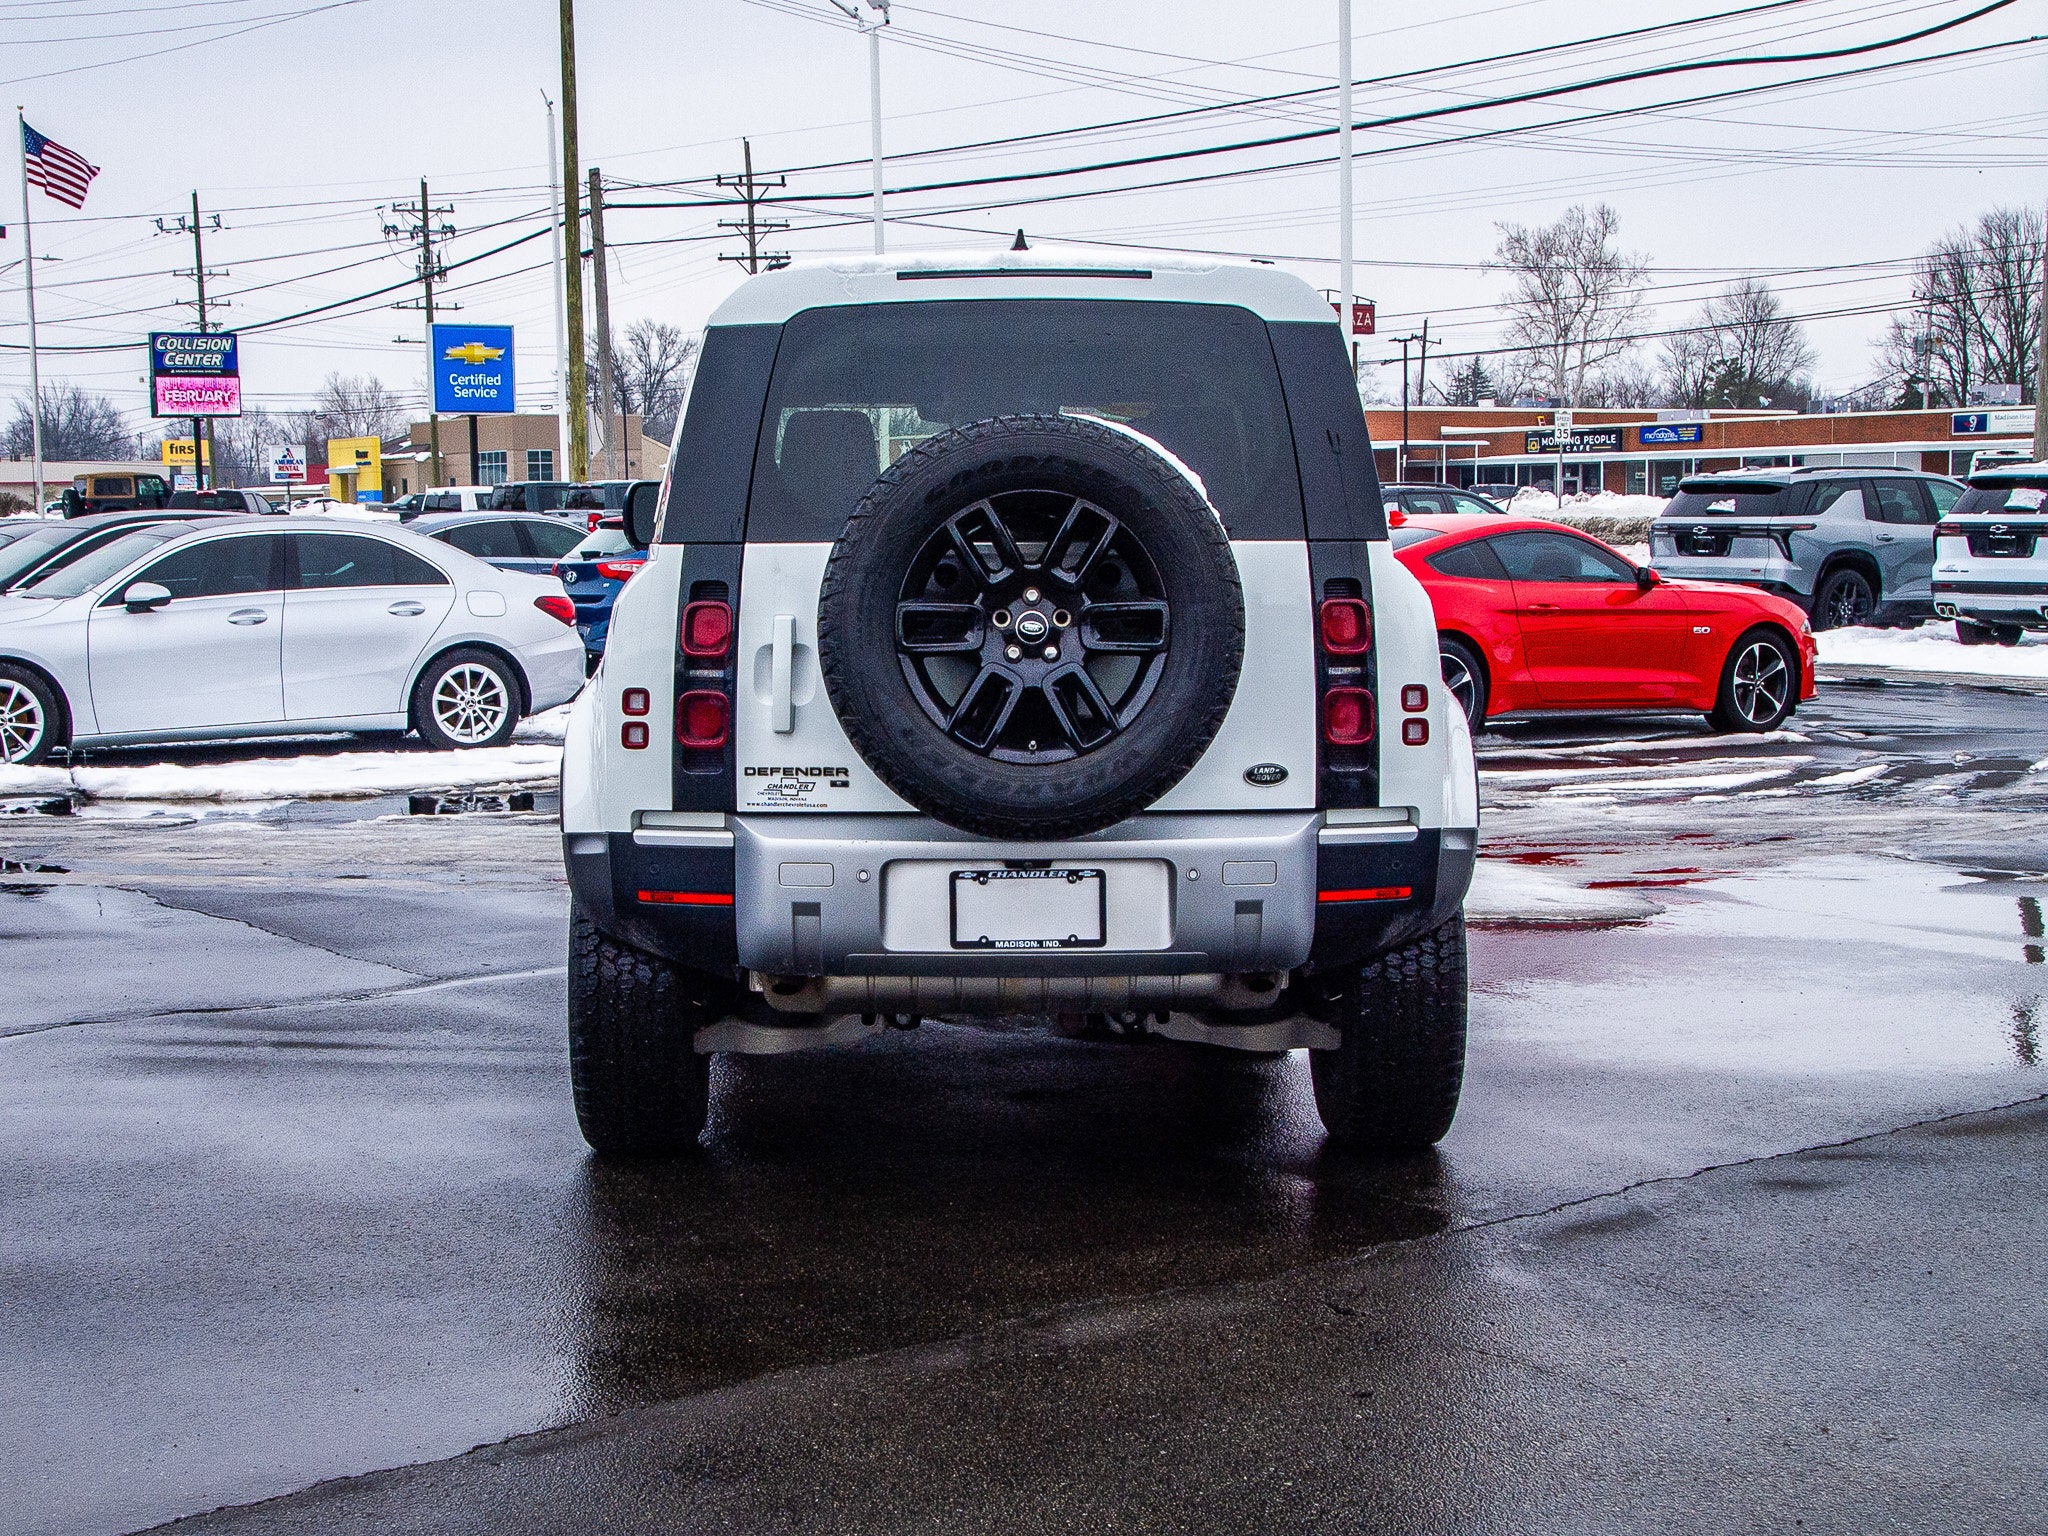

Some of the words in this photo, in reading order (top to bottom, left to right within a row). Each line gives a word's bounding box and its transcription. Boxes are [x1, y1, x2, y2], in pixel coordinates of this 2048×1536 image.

[156, 336, 233, 351] COLLISION
[164, 353, 223, 366] CENTER
[449, 373, 502, 386] Certified
[164, 389, 231, 402] FEBRUARY
[453, 386, 498, 398] Service
[1556, 429, 1569, 439] 35
[1583, 434, 1617, 445] PEOPLE
[1565, 444, 1590, 452] CAFE
[744, 767, 849, 776] DEFENDER
